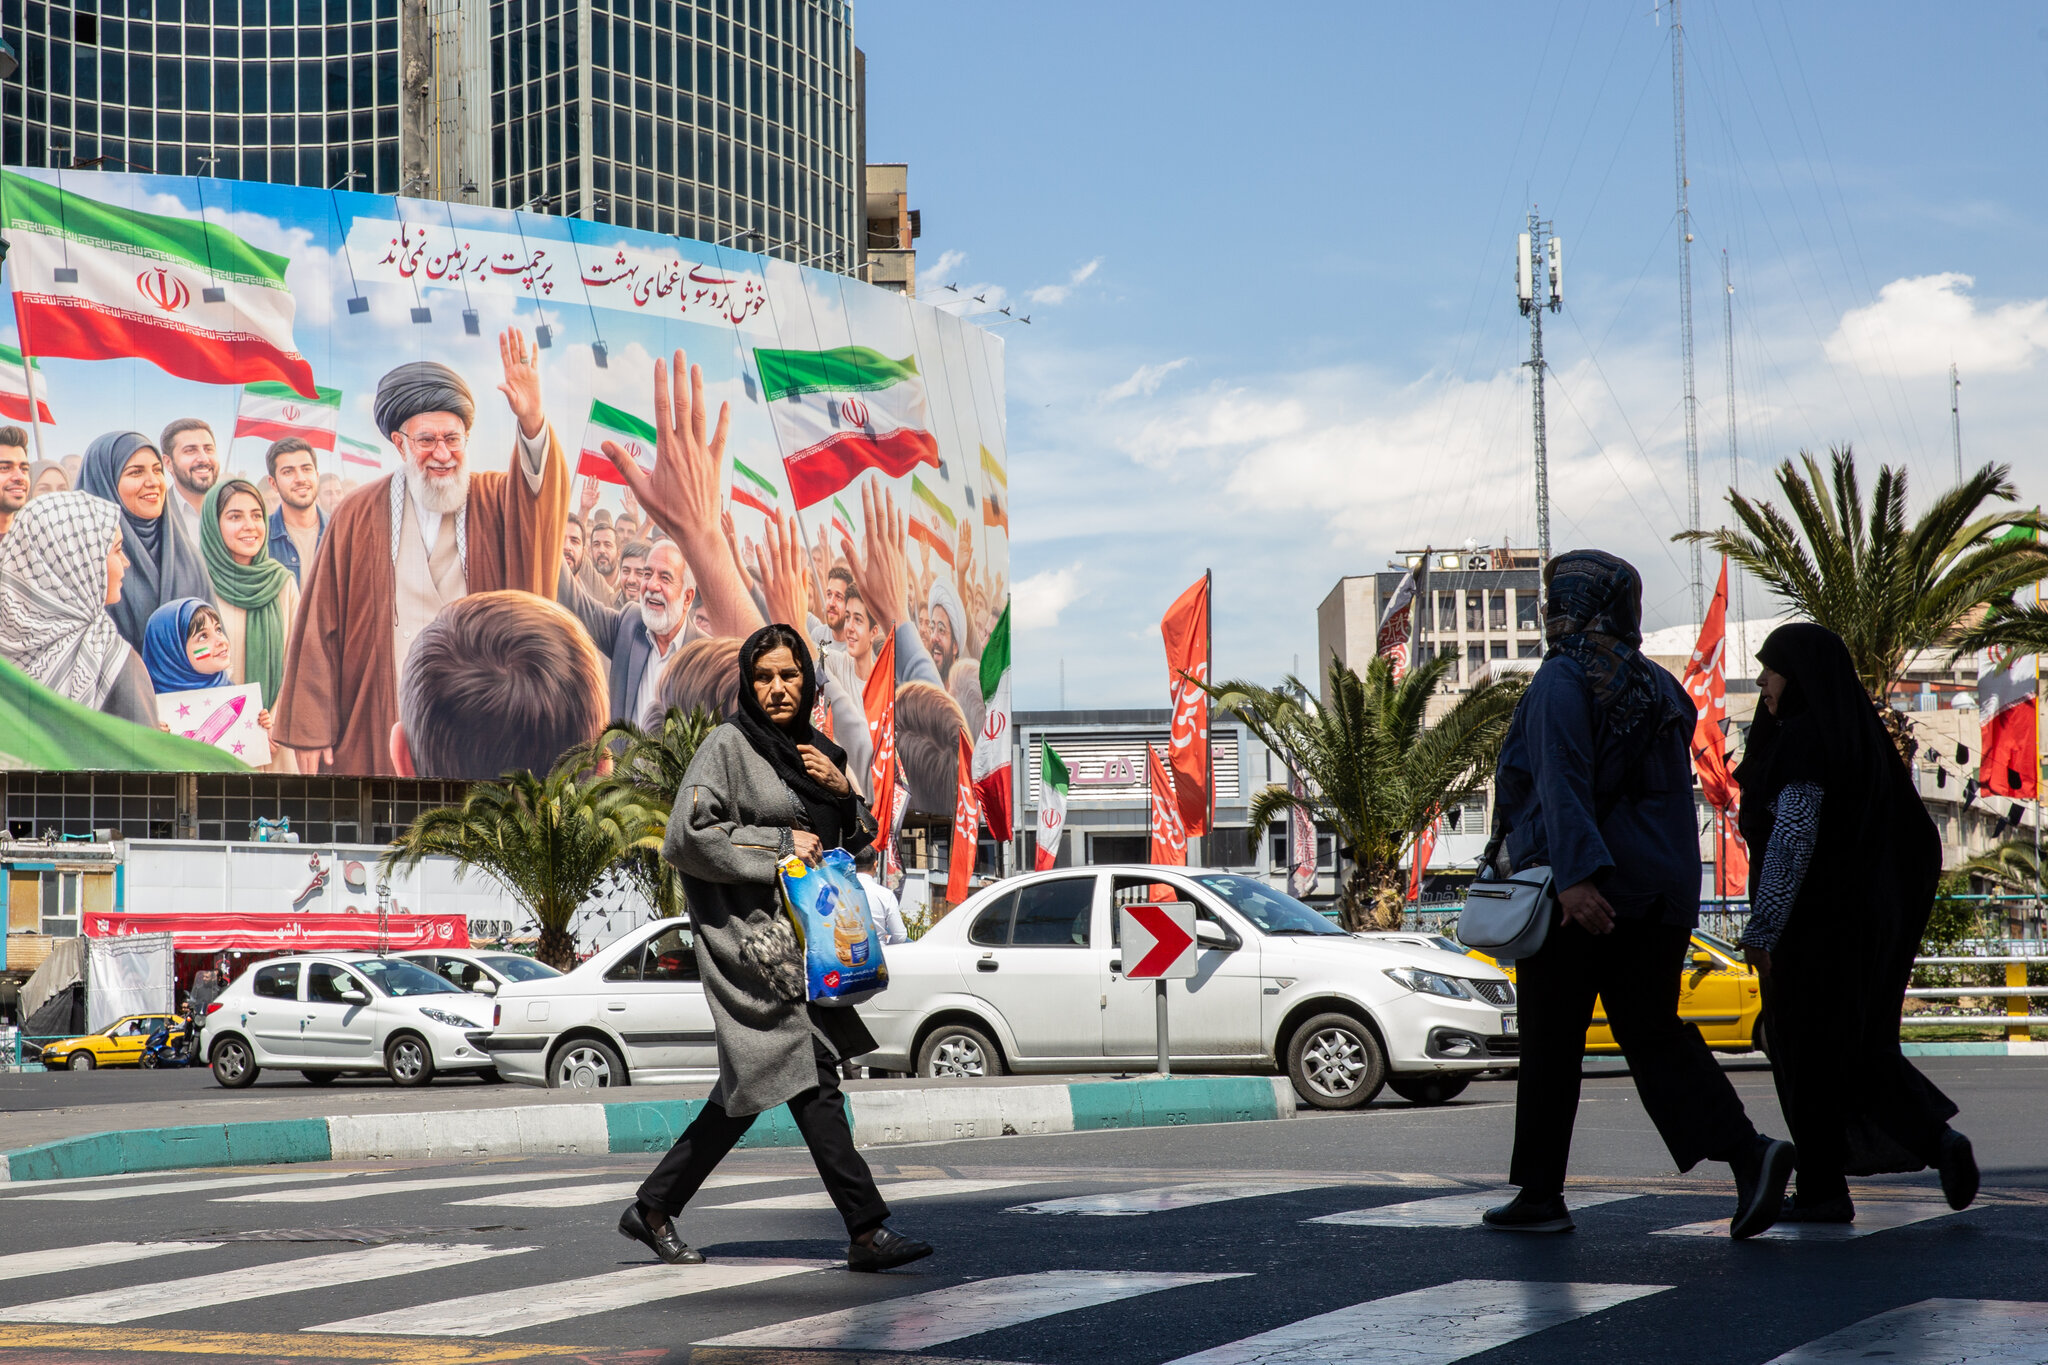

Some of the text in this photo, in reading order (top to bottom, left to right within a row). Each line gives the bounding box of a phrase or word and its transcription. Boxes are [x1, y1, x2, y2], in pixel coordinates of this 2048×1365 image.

[425, 242, 471, 281] زمین
[470, 254, 489, 283] بر
[490, 249, 554, 295] پرچمت
[580, 250, 640, 291] بهشت
[731, 280, 766, 324] خوش
